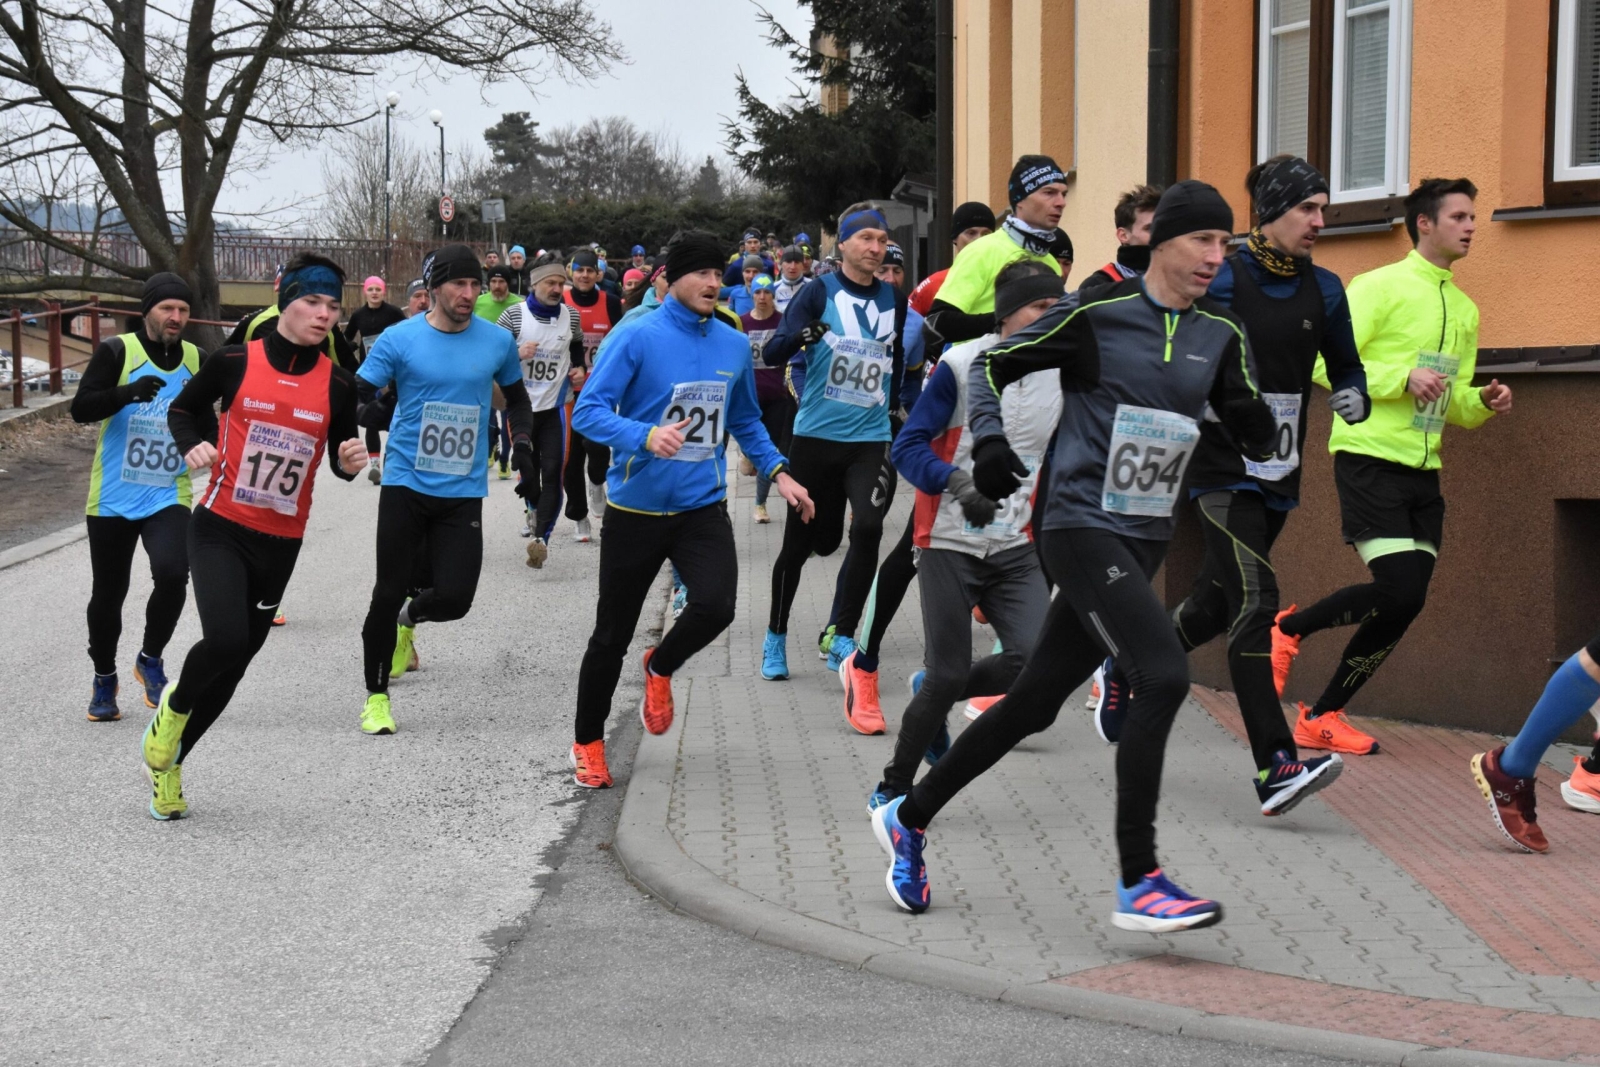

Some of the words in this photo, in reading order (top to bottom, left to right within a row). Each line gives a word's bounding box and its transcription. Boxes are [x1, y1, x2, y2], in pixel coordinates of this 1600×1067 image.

[869, 351, 884, 360] LIGA
[527, 360, 558, 381] 195
[831, 355, 881, 393] 648
[707, 393, 724, 402] LIGA
[425, 404, 450, 413] ZIMNÍ
[1281, 408, 1296, 417] LIGA
[130, 417, 155, 427] ZIMNÍ
[1119, 411, 1154, 424] ZIMNÍ
[252, 424, 281, 439] ZIMNÍ
[666, 405, 719, 445] 221
[421, 423, 475, 460] 668
[1170, 432, 1194, 442] LIGA
[127, 437, 180, 473] 658
[293, 445, 314, 457] LIGA
[247, 451, 304, 496] 175
[1112, 442, 1187, 494] 654
